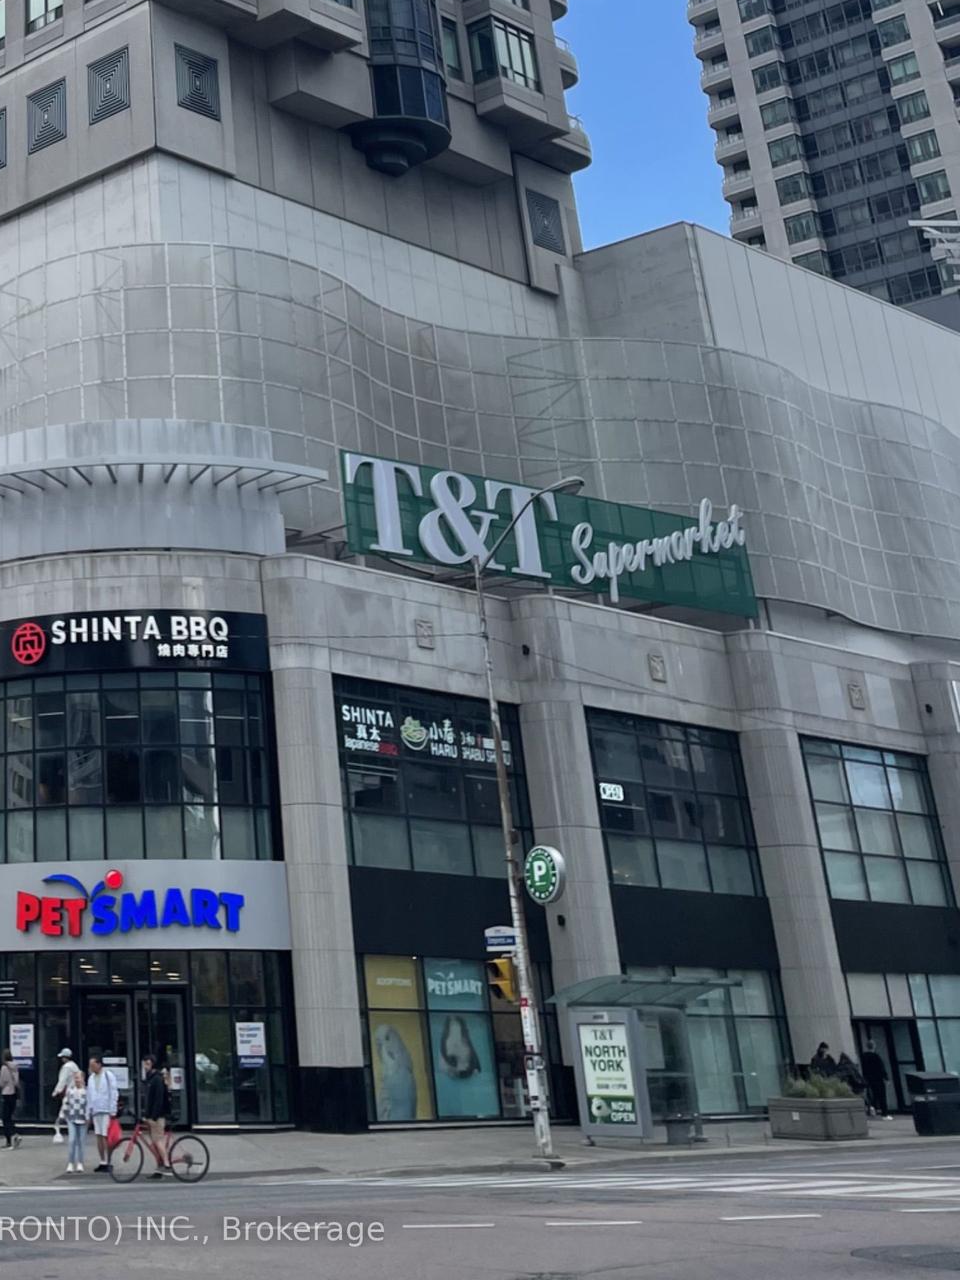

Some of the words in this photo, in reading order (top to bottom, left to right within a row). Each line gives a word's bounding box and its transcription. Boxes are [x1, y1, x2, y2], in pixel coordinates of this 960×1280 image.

[344, 452, 559, 579] T&T
[570, 496, 746, 604] Supermarket
[50, 615, 162, 645] SHINTA
[170, 616, 230, 642] BBQ
[341, 704, 395, 728] SHINTA
[430, 743, 459, 759] HARU
[532, 860, 548, 882] P
[16, 887, 245, 938] PETSMART
[426, 977, 483, 995] PETSMART
[591, 1028, 614, 1041] T&T
[584, 1045, 628, 1058] NORTH
[590, 1059, 625, 1073] YORK
[610, 1101, 634, 1112] NOW
[610, 1112, 637, 1123] OPEN
